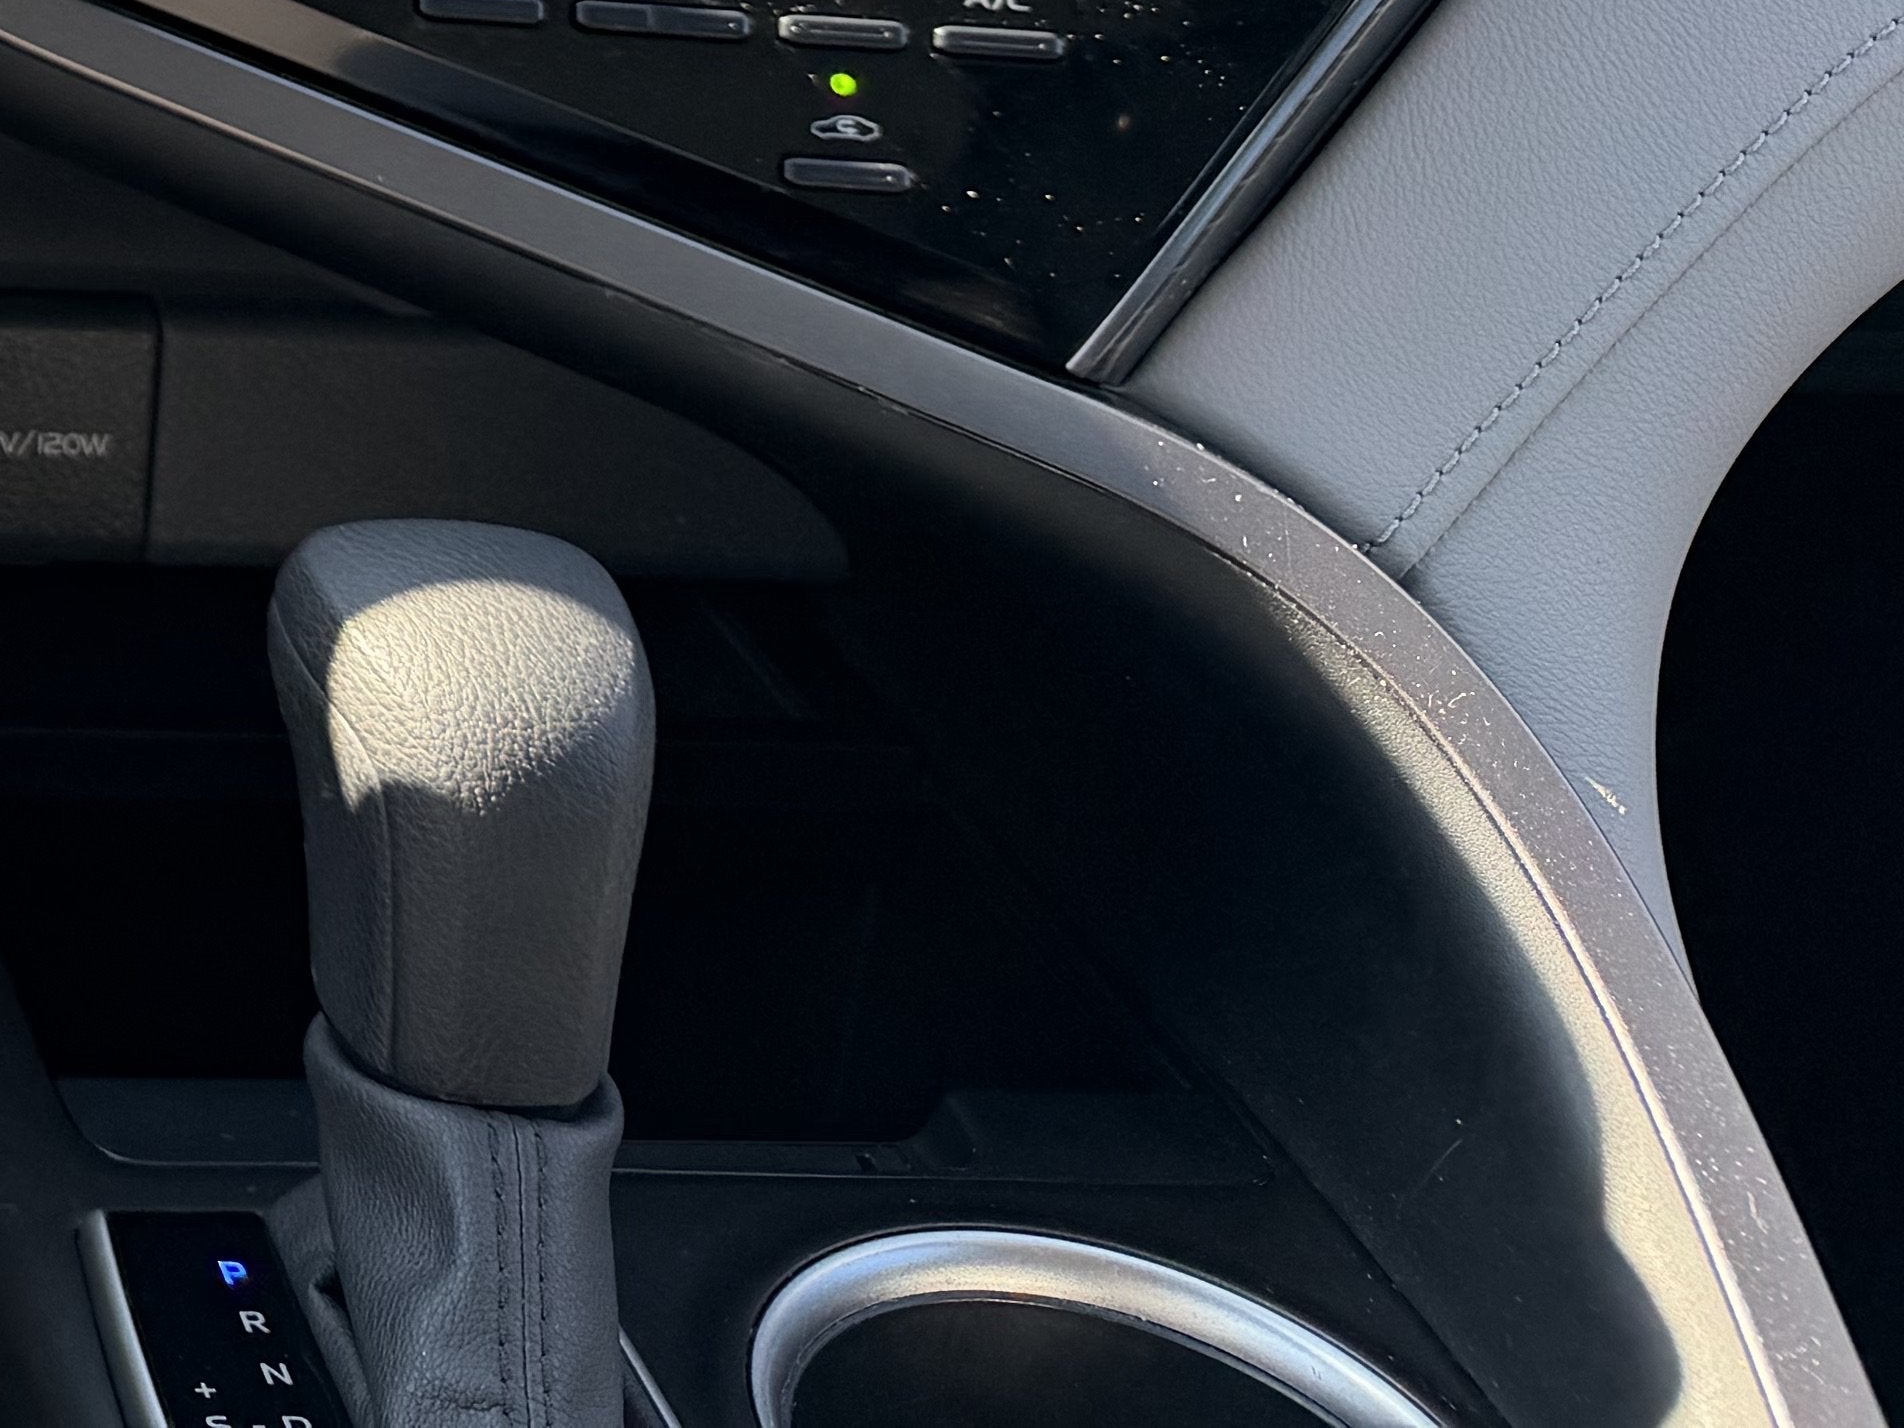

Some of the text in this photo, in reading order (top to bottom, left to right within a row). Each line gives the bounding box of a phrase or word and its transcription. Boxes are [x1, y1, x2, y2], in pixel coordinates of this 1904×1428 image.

[217, 1260, 248, 1286] P
[239, 1310, 271, 1333] R
[259, 1362, 294, 1386] N
